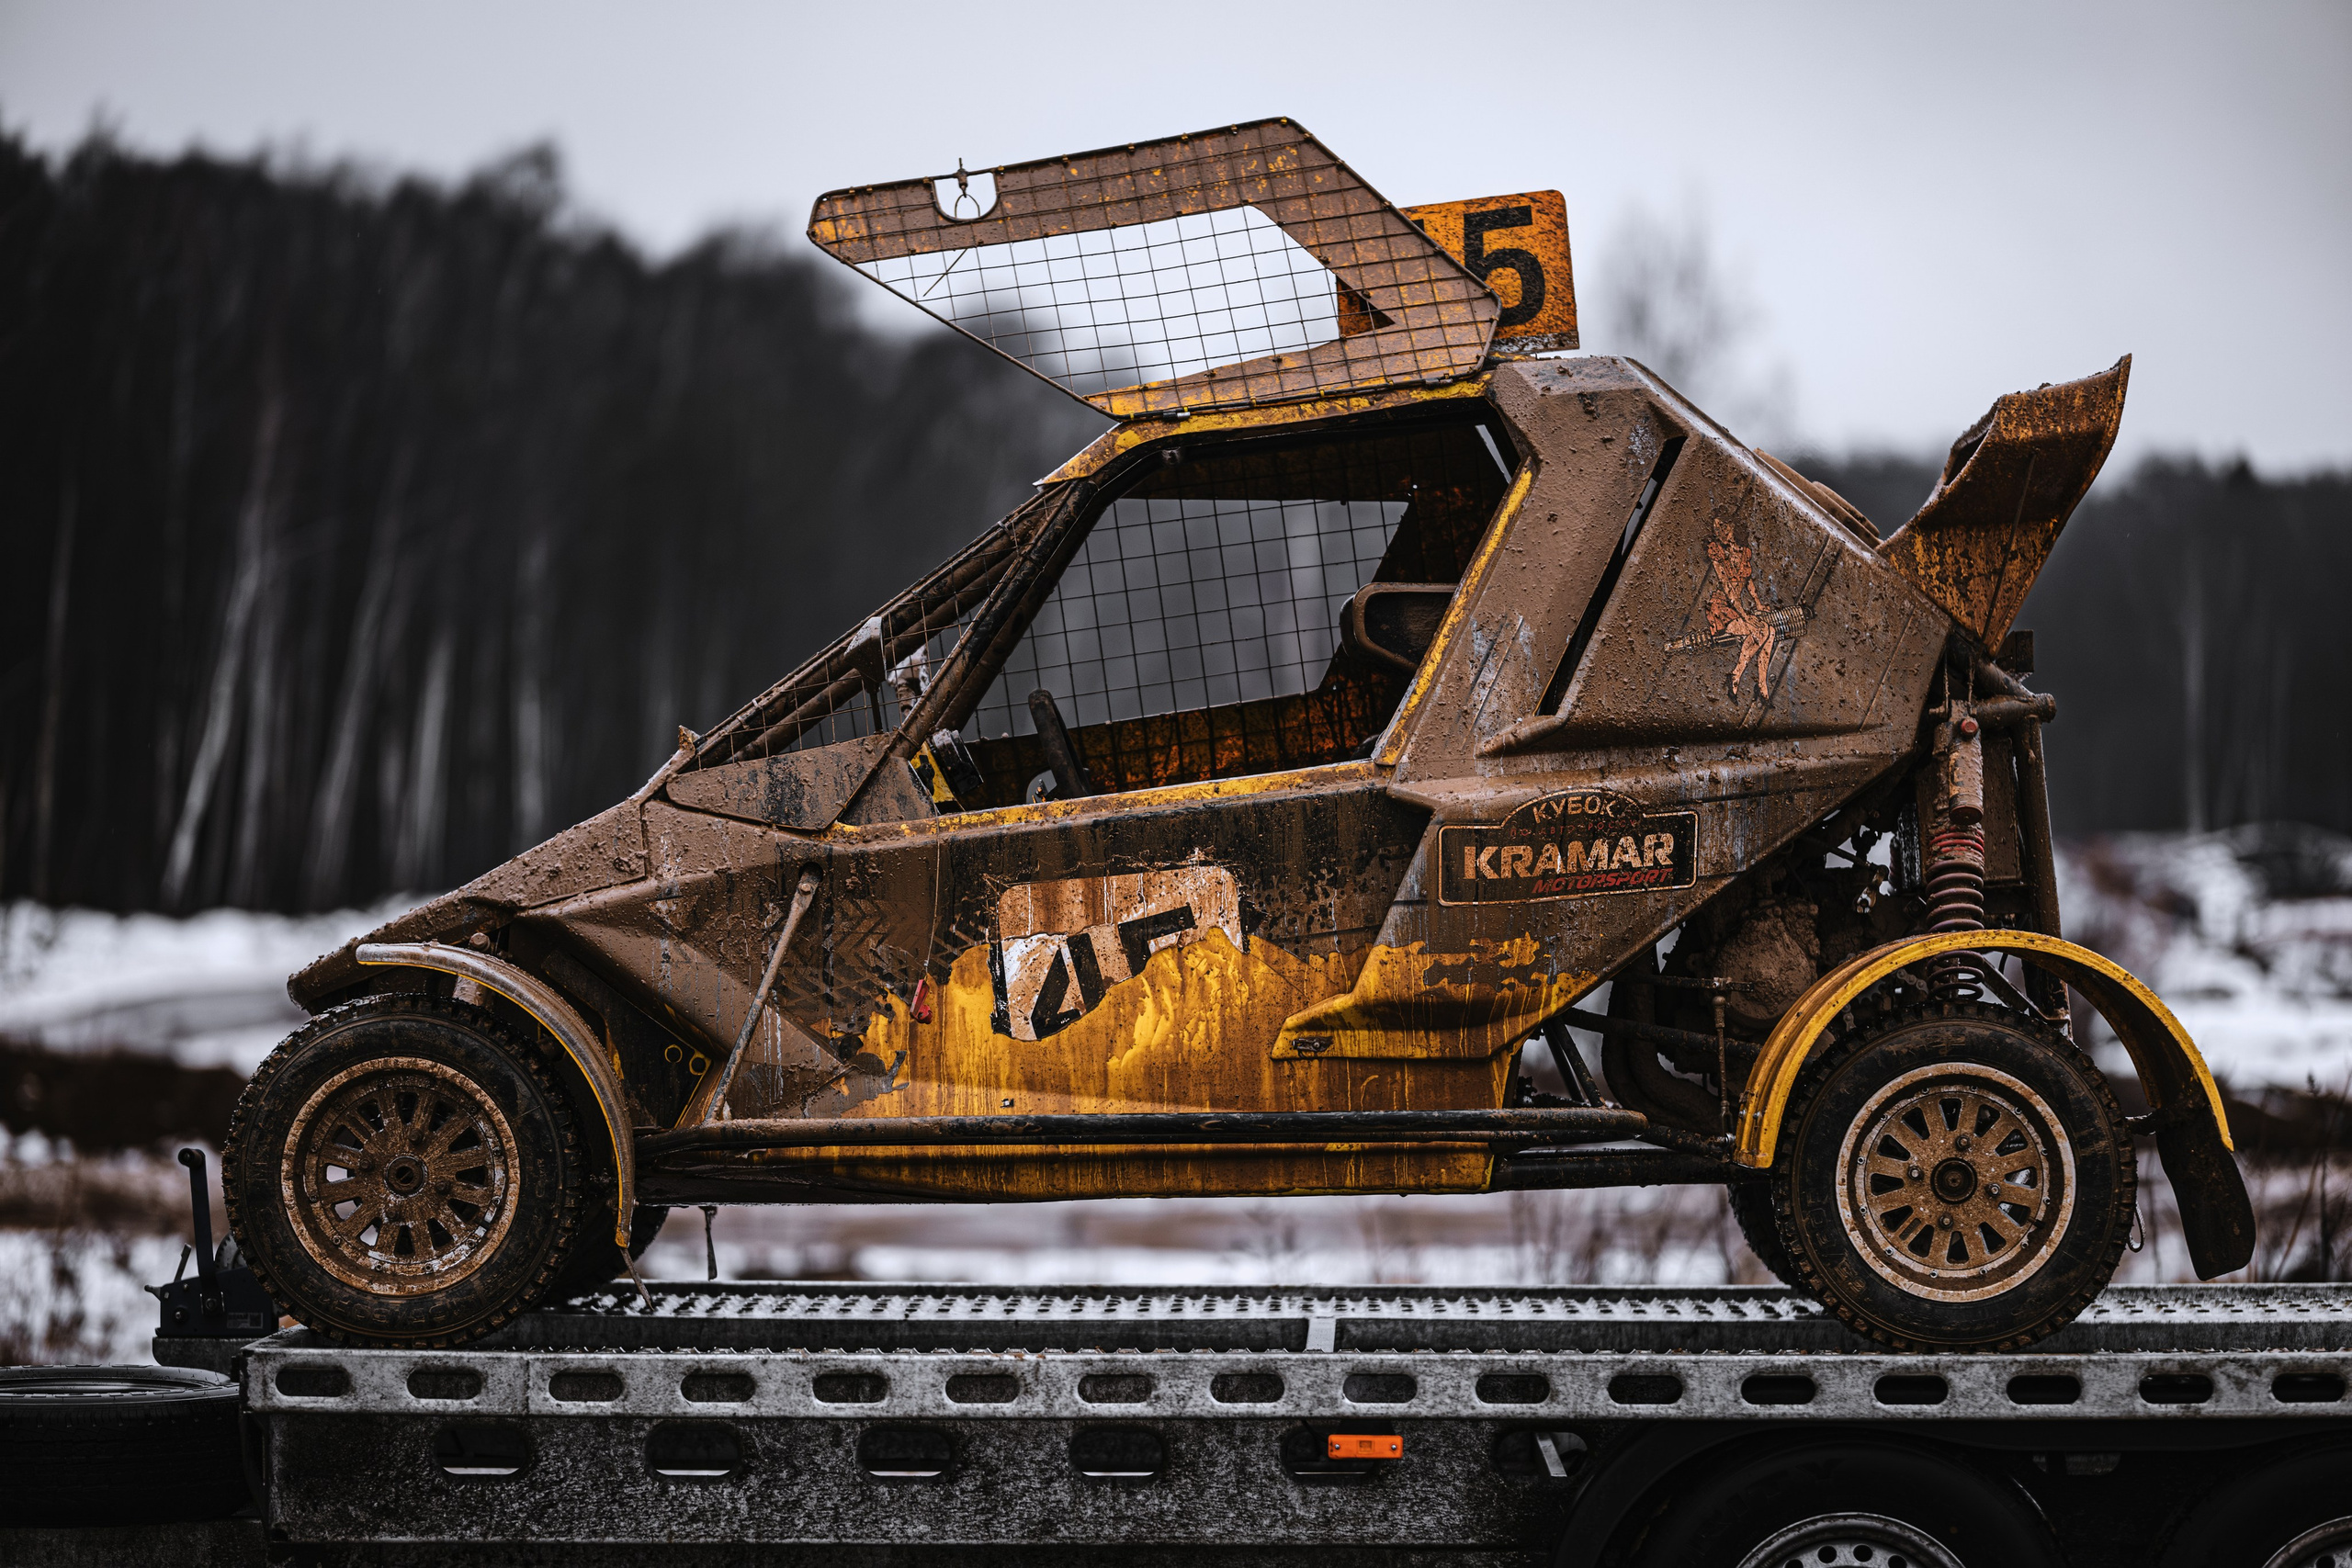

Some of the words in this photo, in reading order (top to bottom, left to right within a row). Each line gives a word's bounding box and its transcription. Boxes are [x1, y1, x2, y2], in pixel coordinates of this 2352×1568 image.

[1412, 205, 1546, 327] 5
[1532, 795, 1617, 824] КУБОК
[1463, 832, 1674, 880] KRAMAR
[1532, 868, 1674, 894] MOTORSPORT
